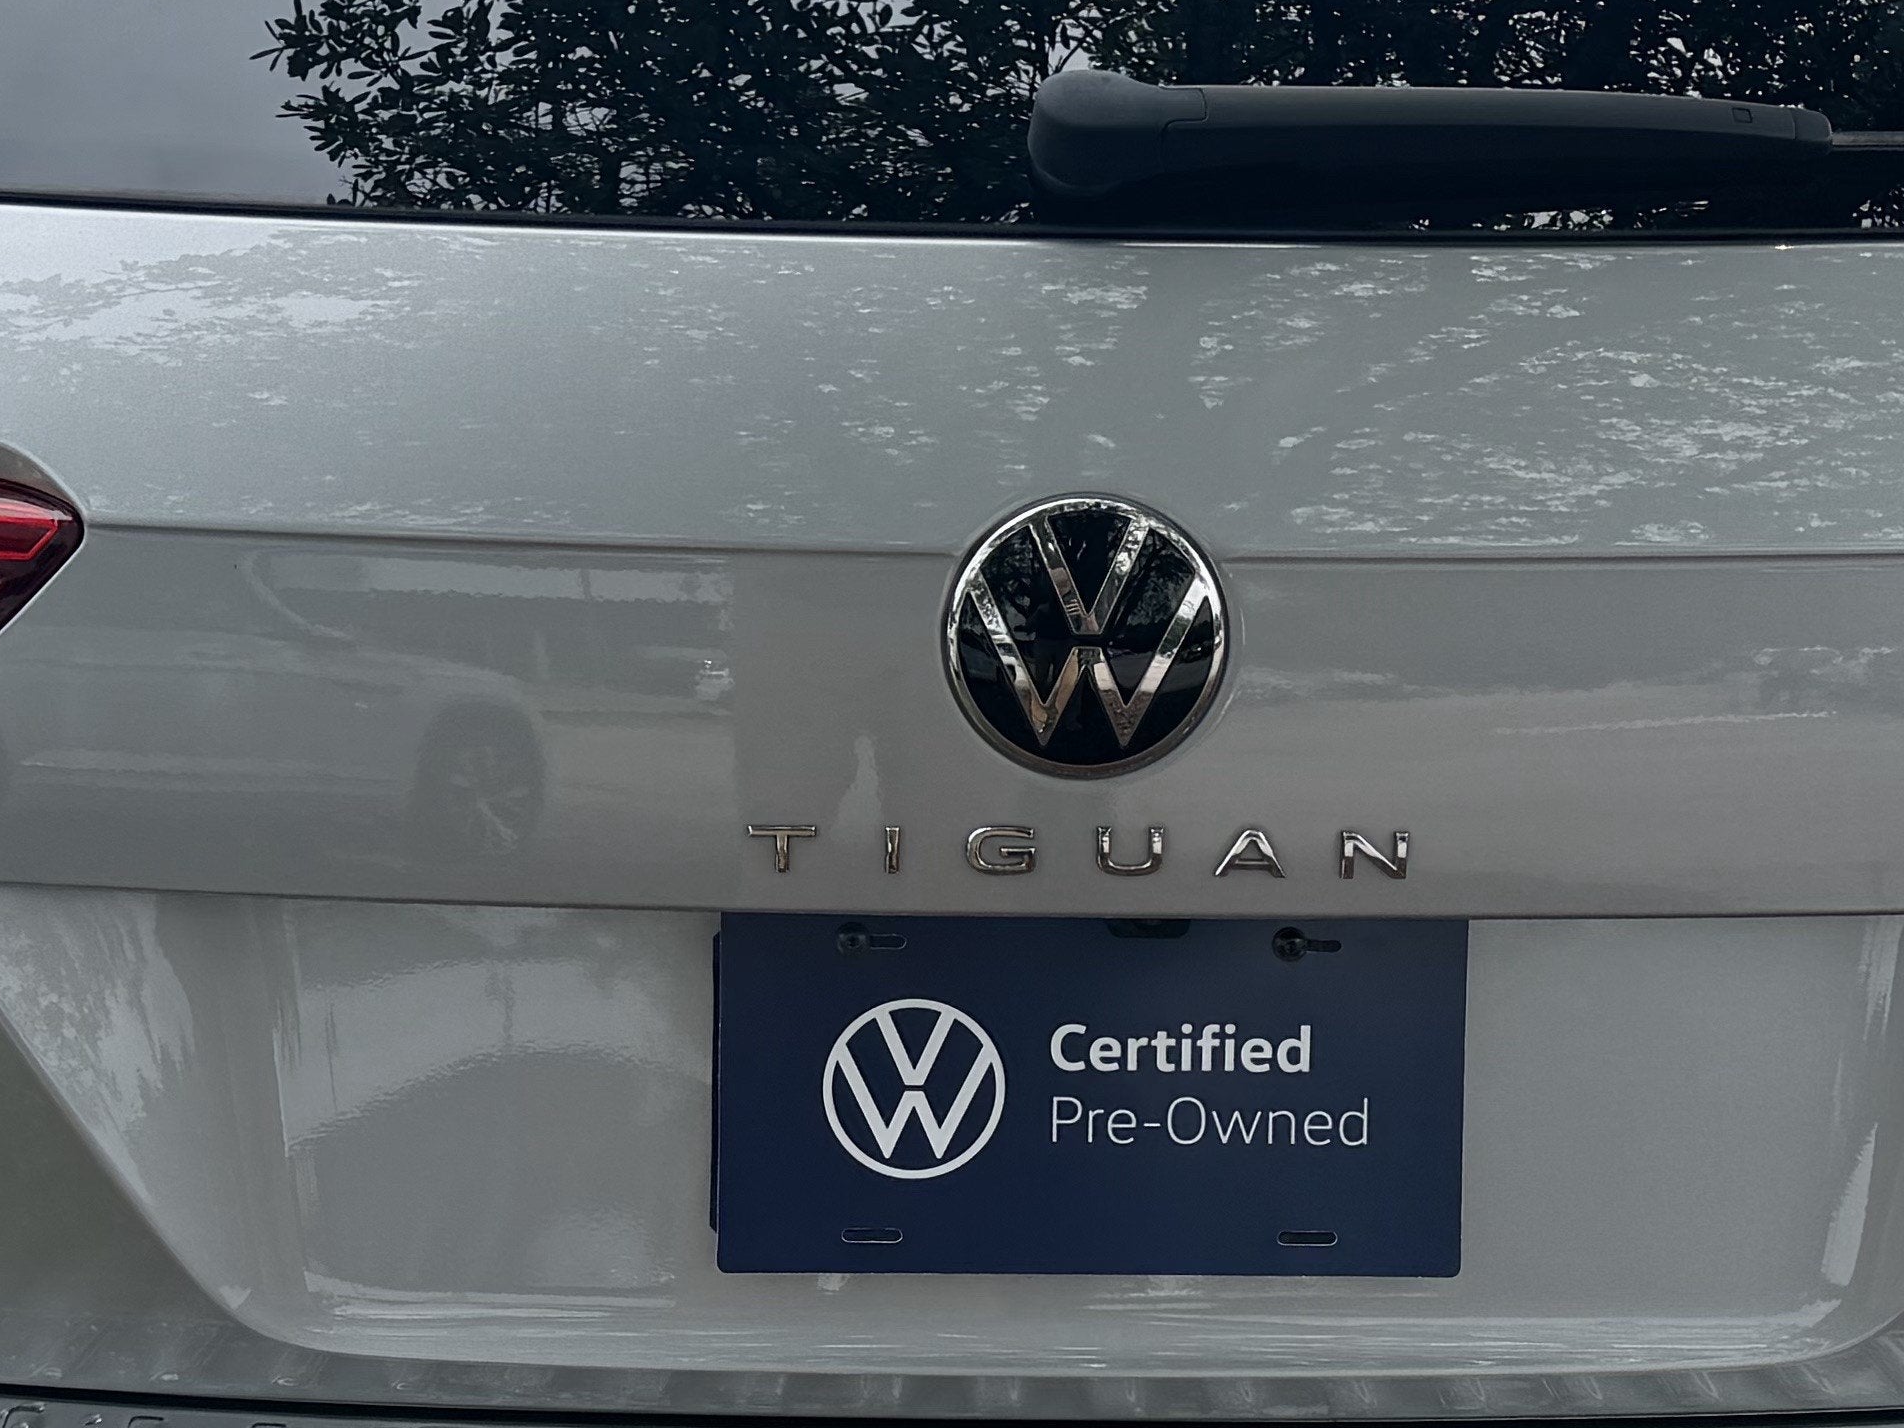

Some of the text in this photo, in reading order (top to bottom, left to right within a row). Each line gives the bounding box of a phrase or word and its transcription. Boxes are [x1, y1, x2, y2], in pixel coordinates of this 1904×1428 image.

[746, 822, 1412, 882] TIGUAN
[1048, 1022, 1313, 1075] Certified
[1050, 1094, 1371, 1148] Pre-Owned
